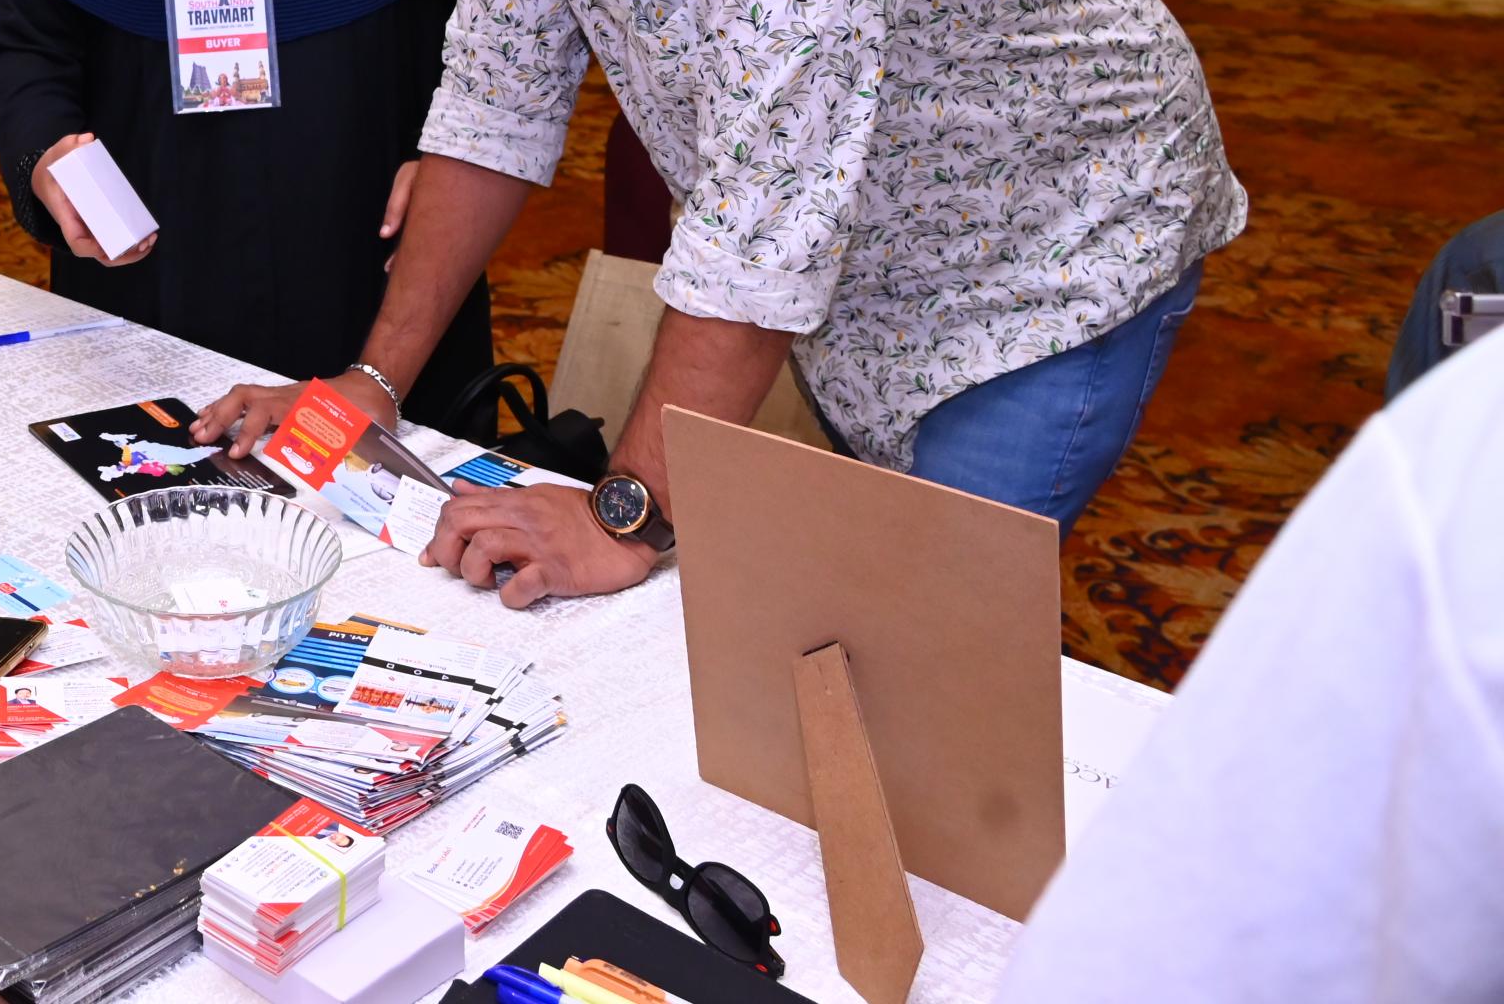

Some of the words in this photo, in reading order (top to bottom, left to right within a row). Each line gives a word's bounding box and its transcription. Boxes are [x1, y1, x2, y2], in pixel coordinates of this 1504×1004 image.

[187, 6, 255, 26] TRAVMART
[205, 37, 241, 49] BUYER
[328, 630, 346, 639] Ltd
